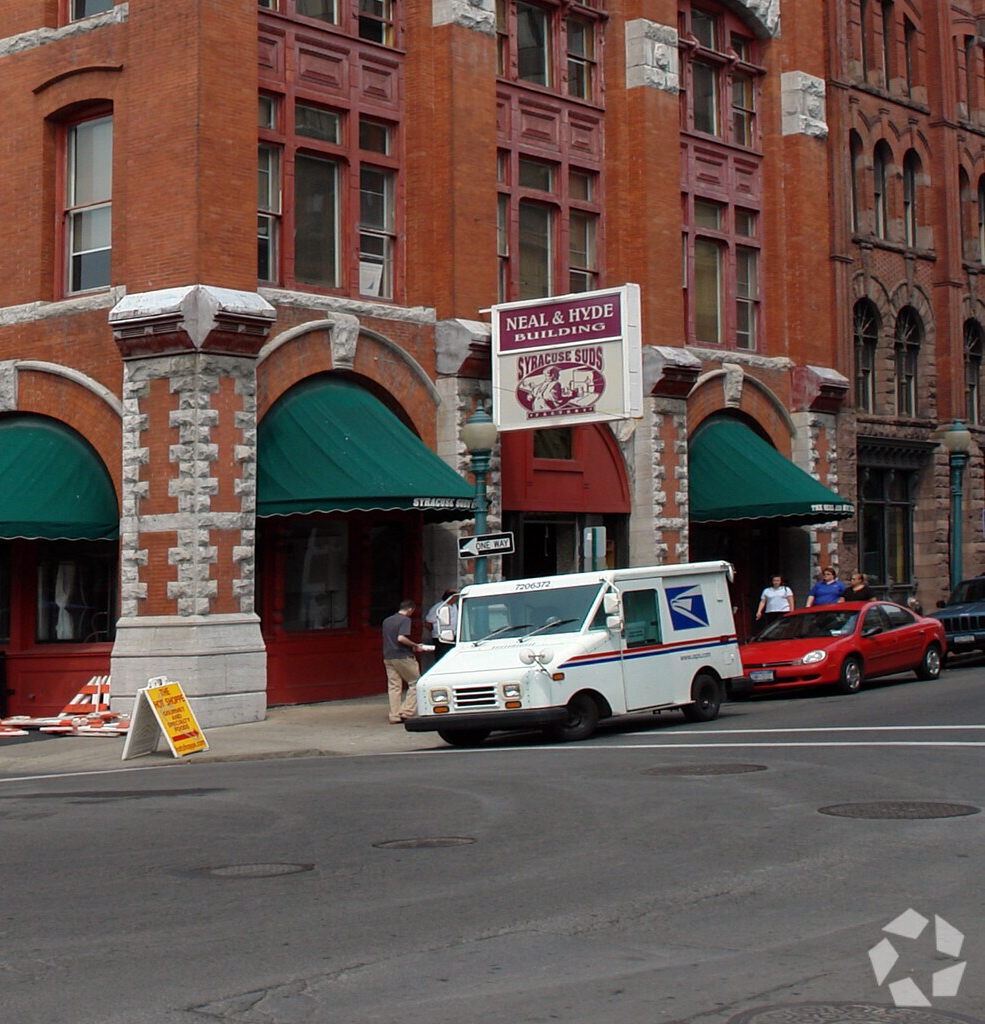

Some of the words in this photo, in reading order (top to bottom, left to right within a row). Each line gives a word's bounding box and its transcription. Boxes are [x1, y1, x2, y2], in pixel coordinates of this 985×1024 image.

[507, 313, 548, 331] NEAL
[552, 310, 564, 324] &
[569, 304, 613, 322] HYDE
[515, 322, 606, 342] BUILDING
[518, 350, 571, 380] SYRACUSE
[575, 346, 603, 371] SUDS
[413, 498, 455, 508] SYRACUSE
[476, 542, 489, 550] ONE
[494, 540, 508, 548] WAY
[515, 580, 551, 590] 7206372
